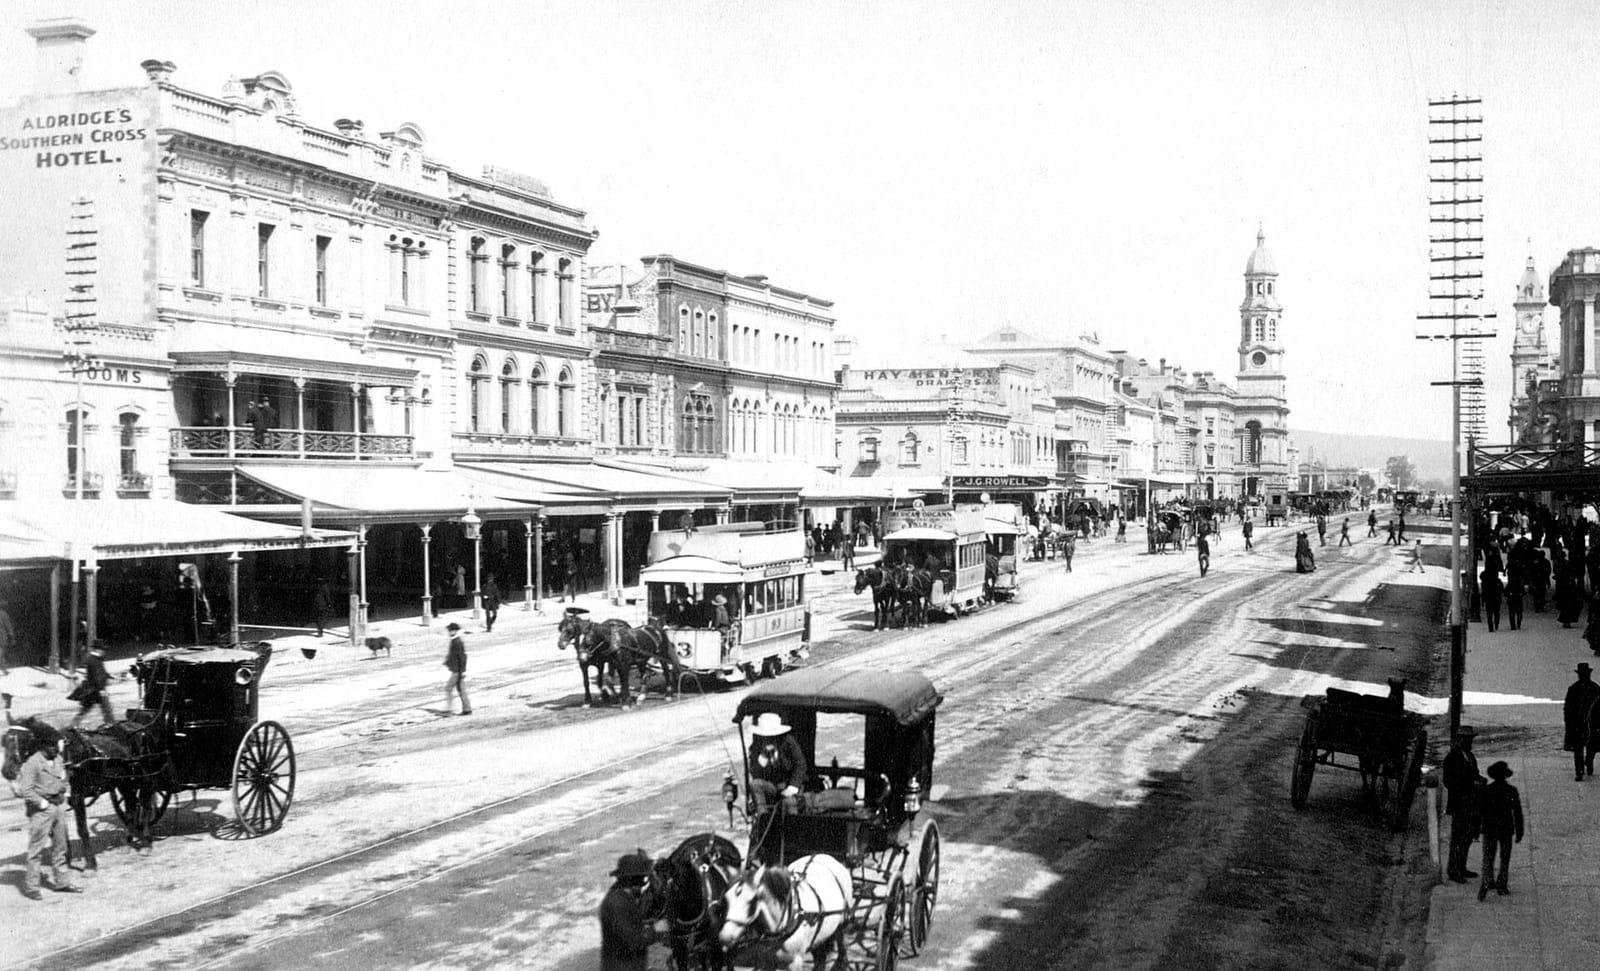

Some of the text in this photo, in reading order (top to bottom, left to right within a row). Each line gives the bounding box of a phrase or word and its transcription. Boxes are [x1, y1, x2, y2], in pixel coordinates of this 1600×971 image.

[22, 108, 132, 130] ALDRIDGE'S
[0, 128, 147, 151] SOUTHERN CROSS
[36, 150, 122, 169] HOTEL.
[864, 370, 902, 380] HAY
[677, 641, 693, 659] 3
